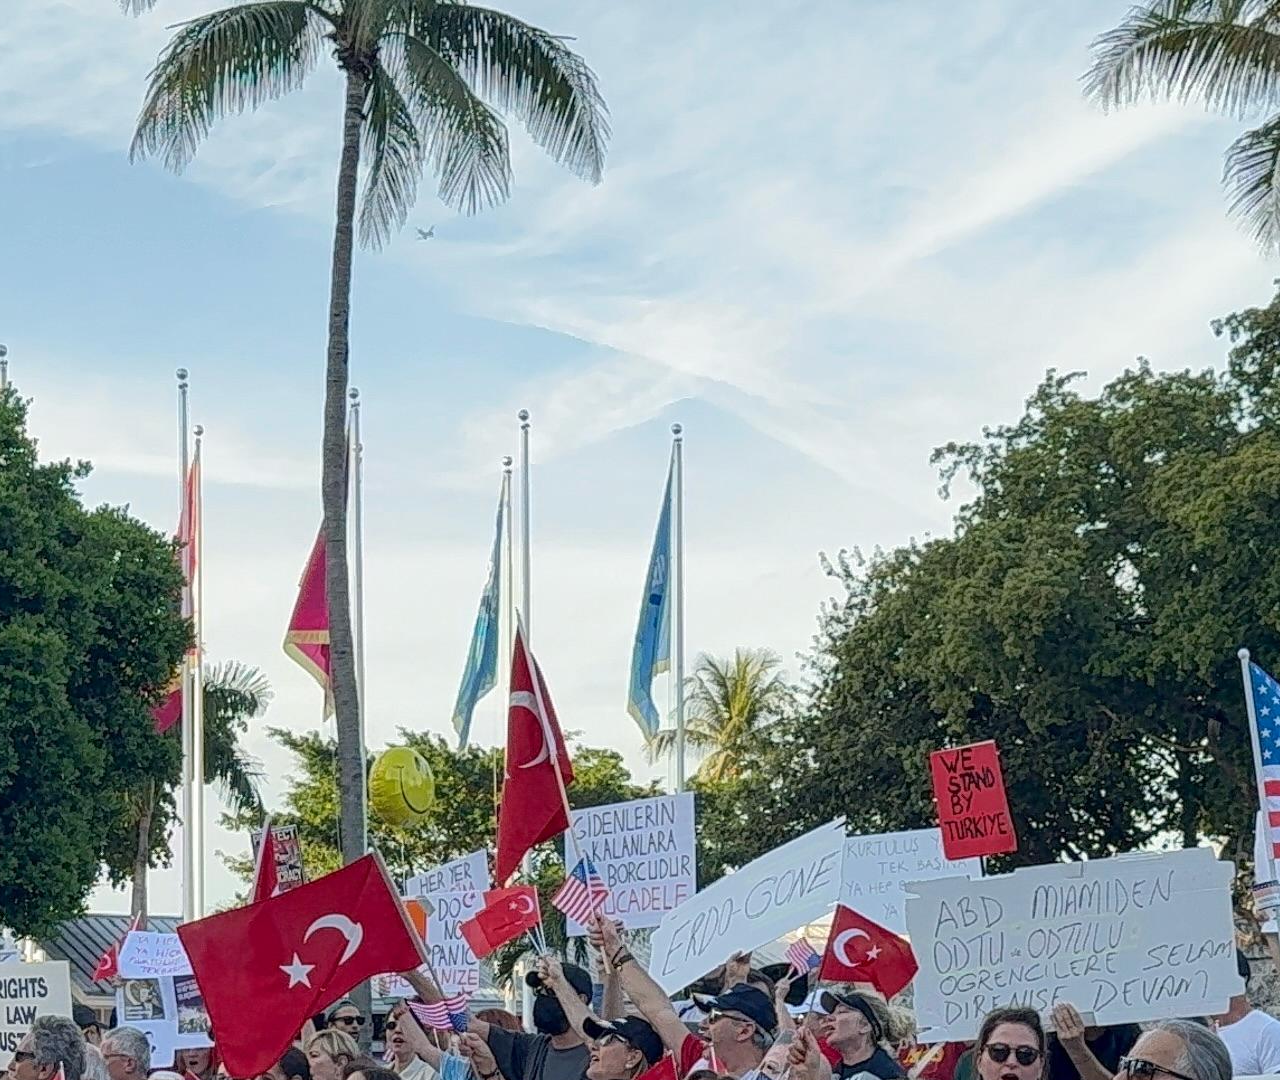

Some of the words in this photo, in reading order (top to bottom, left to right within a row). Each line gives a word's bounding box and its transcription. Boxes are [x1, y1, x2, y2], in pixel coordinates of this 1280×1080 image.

[940, 748, 974, 773] WE
[947, 766, 995, 793] STAND
[950, 791, 973, 815] BY
[592, 829, 677, 862] KALANLARA
[420, 870, 445, 894] HER
[448, 862, 472, 882] YER
[607, 854, 690, 888] BORCUDUR
[878, 861, 909, 875] TEK
[604, 884, 688, 915] ÜCADELE
[846, 880, 863, 896] YA
[662, 850, 841, 976] ERDO-GONE
[933, 896, 1004, 938] ABD
[1031, 870, 1175, 920] MIAMIDEN
[431, 943, 477, 968] PANIC
[933, 931, 1004, 974] ODTU
[1142, 939, 1234, 971] SELAM
[6, 1006, 37, 1024] LAW
